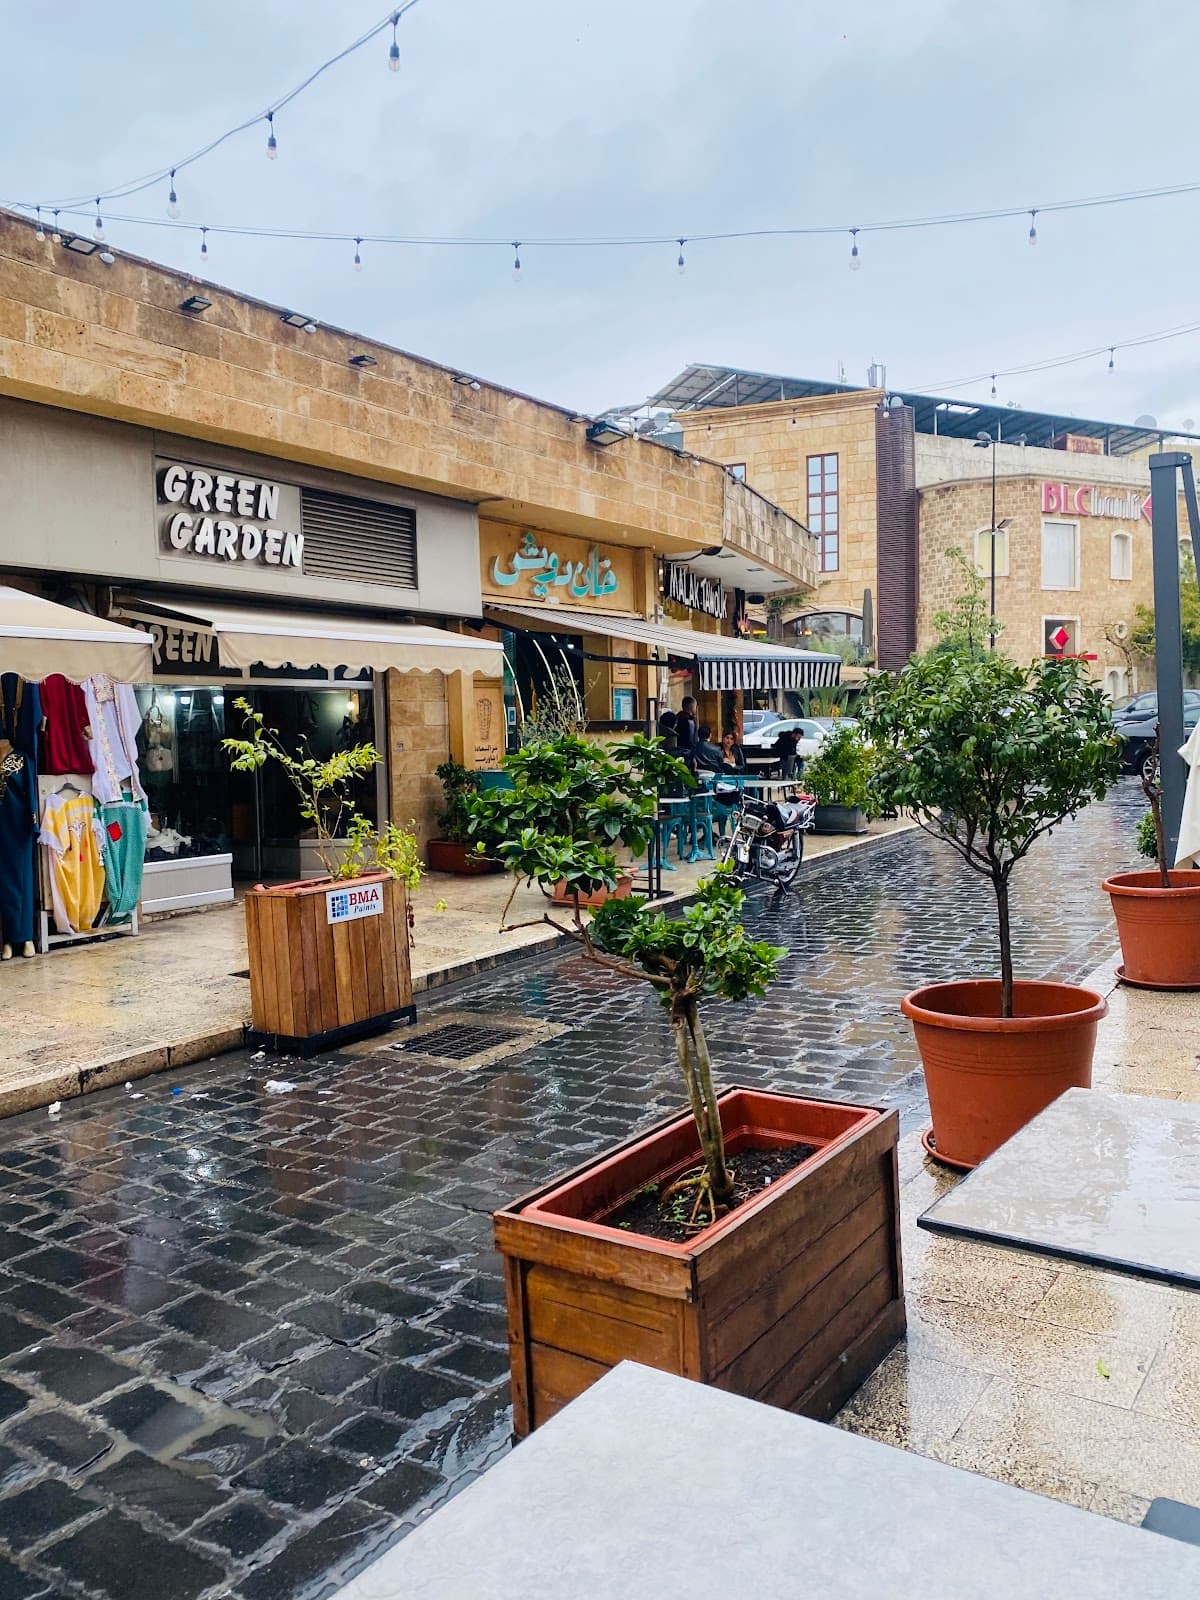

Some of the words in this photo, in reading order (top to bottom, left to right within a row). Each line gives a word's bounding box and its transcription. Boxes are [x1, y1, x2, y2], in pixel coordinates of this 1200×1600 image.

[163, 465, 280, 520] GREEN
[1041, 482, 1092, 517] BLC
[170, 512, 305, 567] GARDEN
[669, 562, 700, 610] MALAK
[349, 889, 379, 906] BMA
[353, 903, 377, 913] Paints
